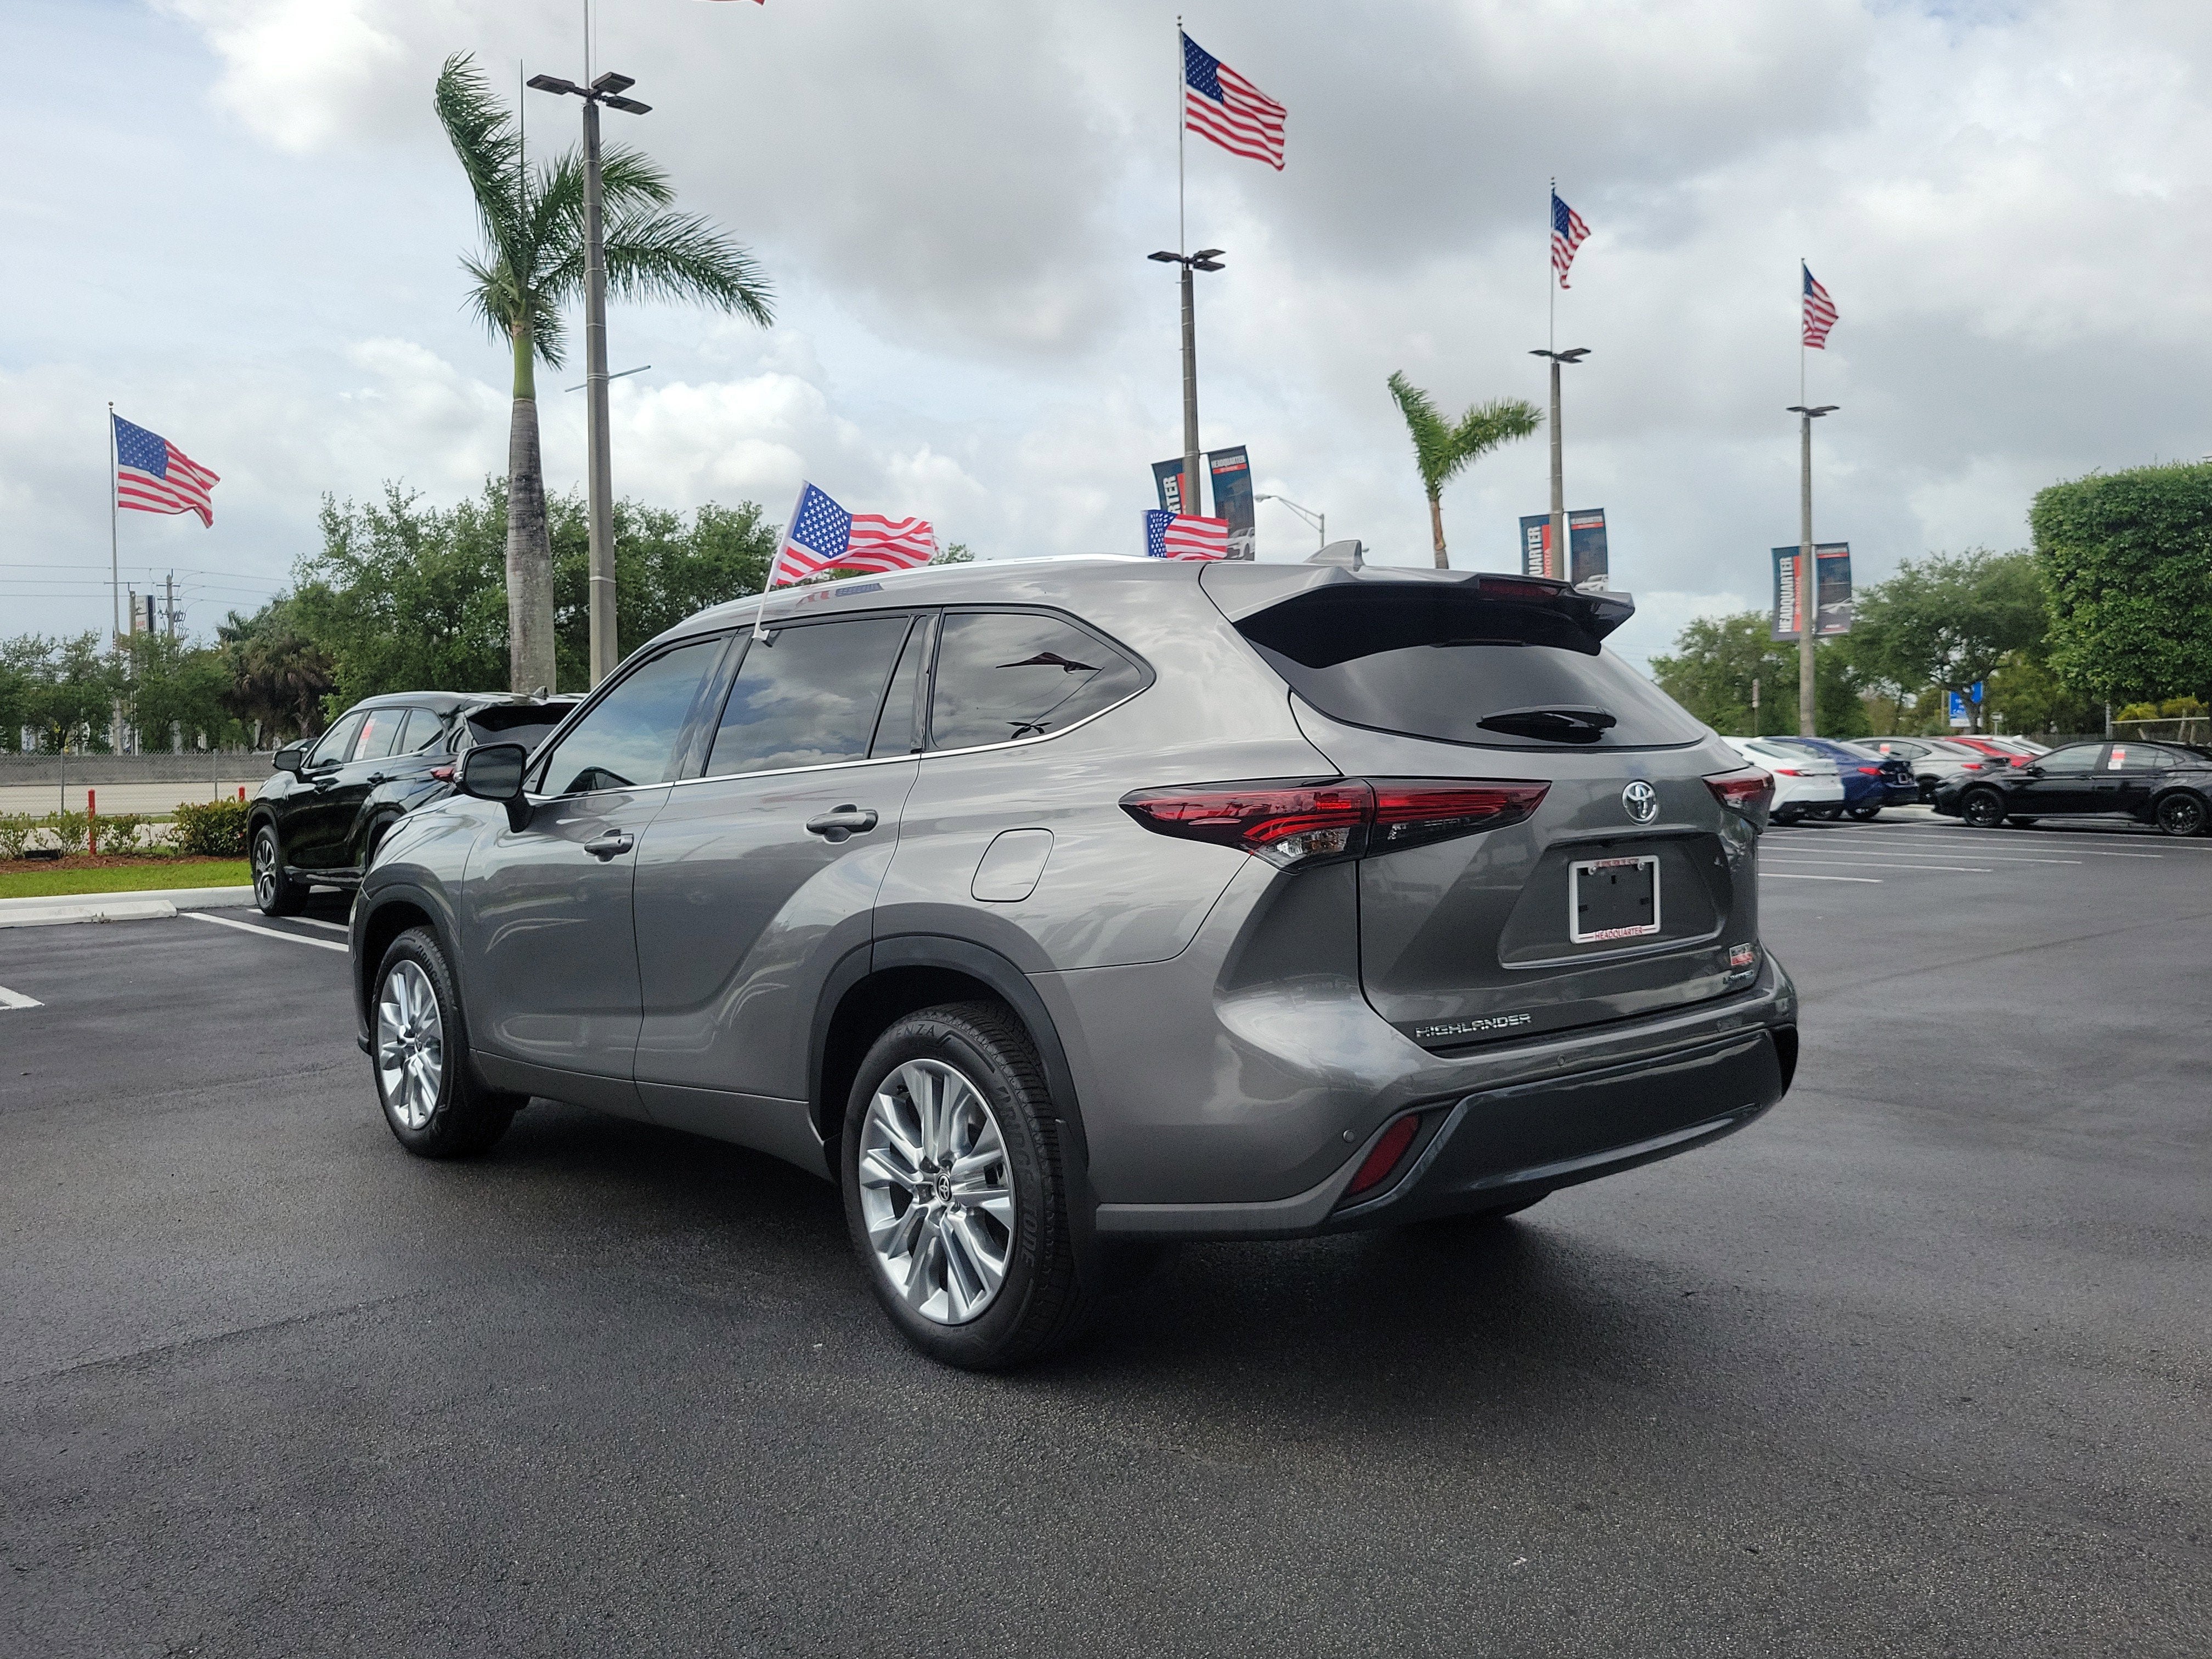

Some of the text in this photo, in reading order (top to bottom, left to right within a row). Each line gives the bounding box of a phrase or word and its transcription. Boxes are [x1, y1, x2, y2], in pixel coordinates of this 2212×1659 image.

[1778, 557, 1794, 633] HEADQUARTER
[1595, 927, 1643, 940] HEADQUARTER
[1415, 1013, 1532, 1038] HIGHLANDER
